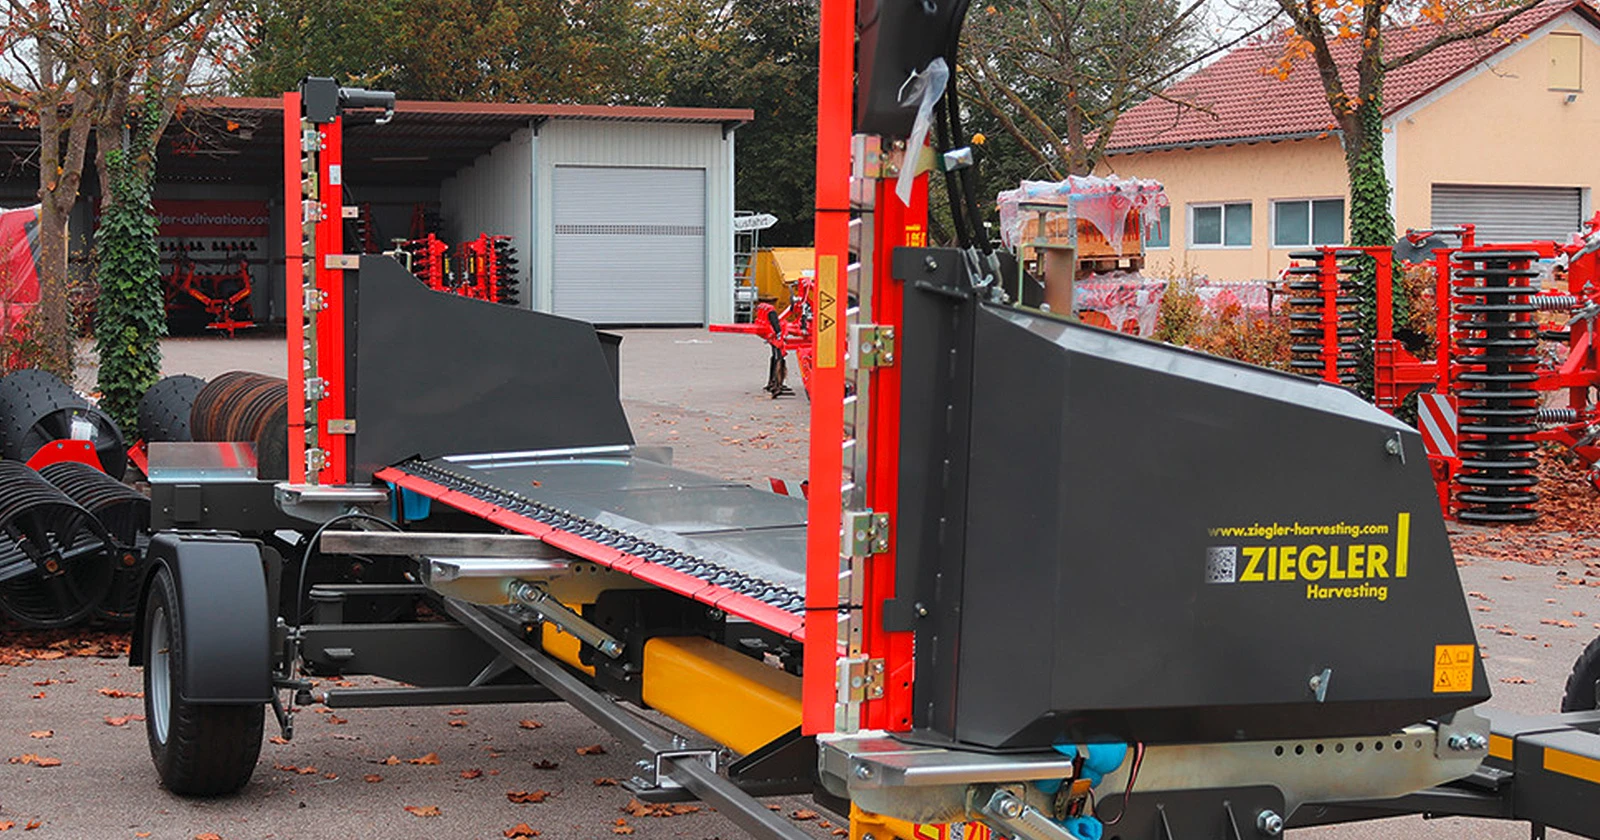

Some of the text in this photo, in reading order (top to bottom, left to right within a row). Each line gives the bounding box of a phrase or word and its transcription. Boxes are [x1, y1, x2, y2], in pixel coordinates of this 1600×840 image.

[1208, 522, 1389, 540] www.ziegler-harvesting.com
[1239, 545, 1390, 582] ZIEGLER
[1306, 582, 1388, 601] Harvesting
